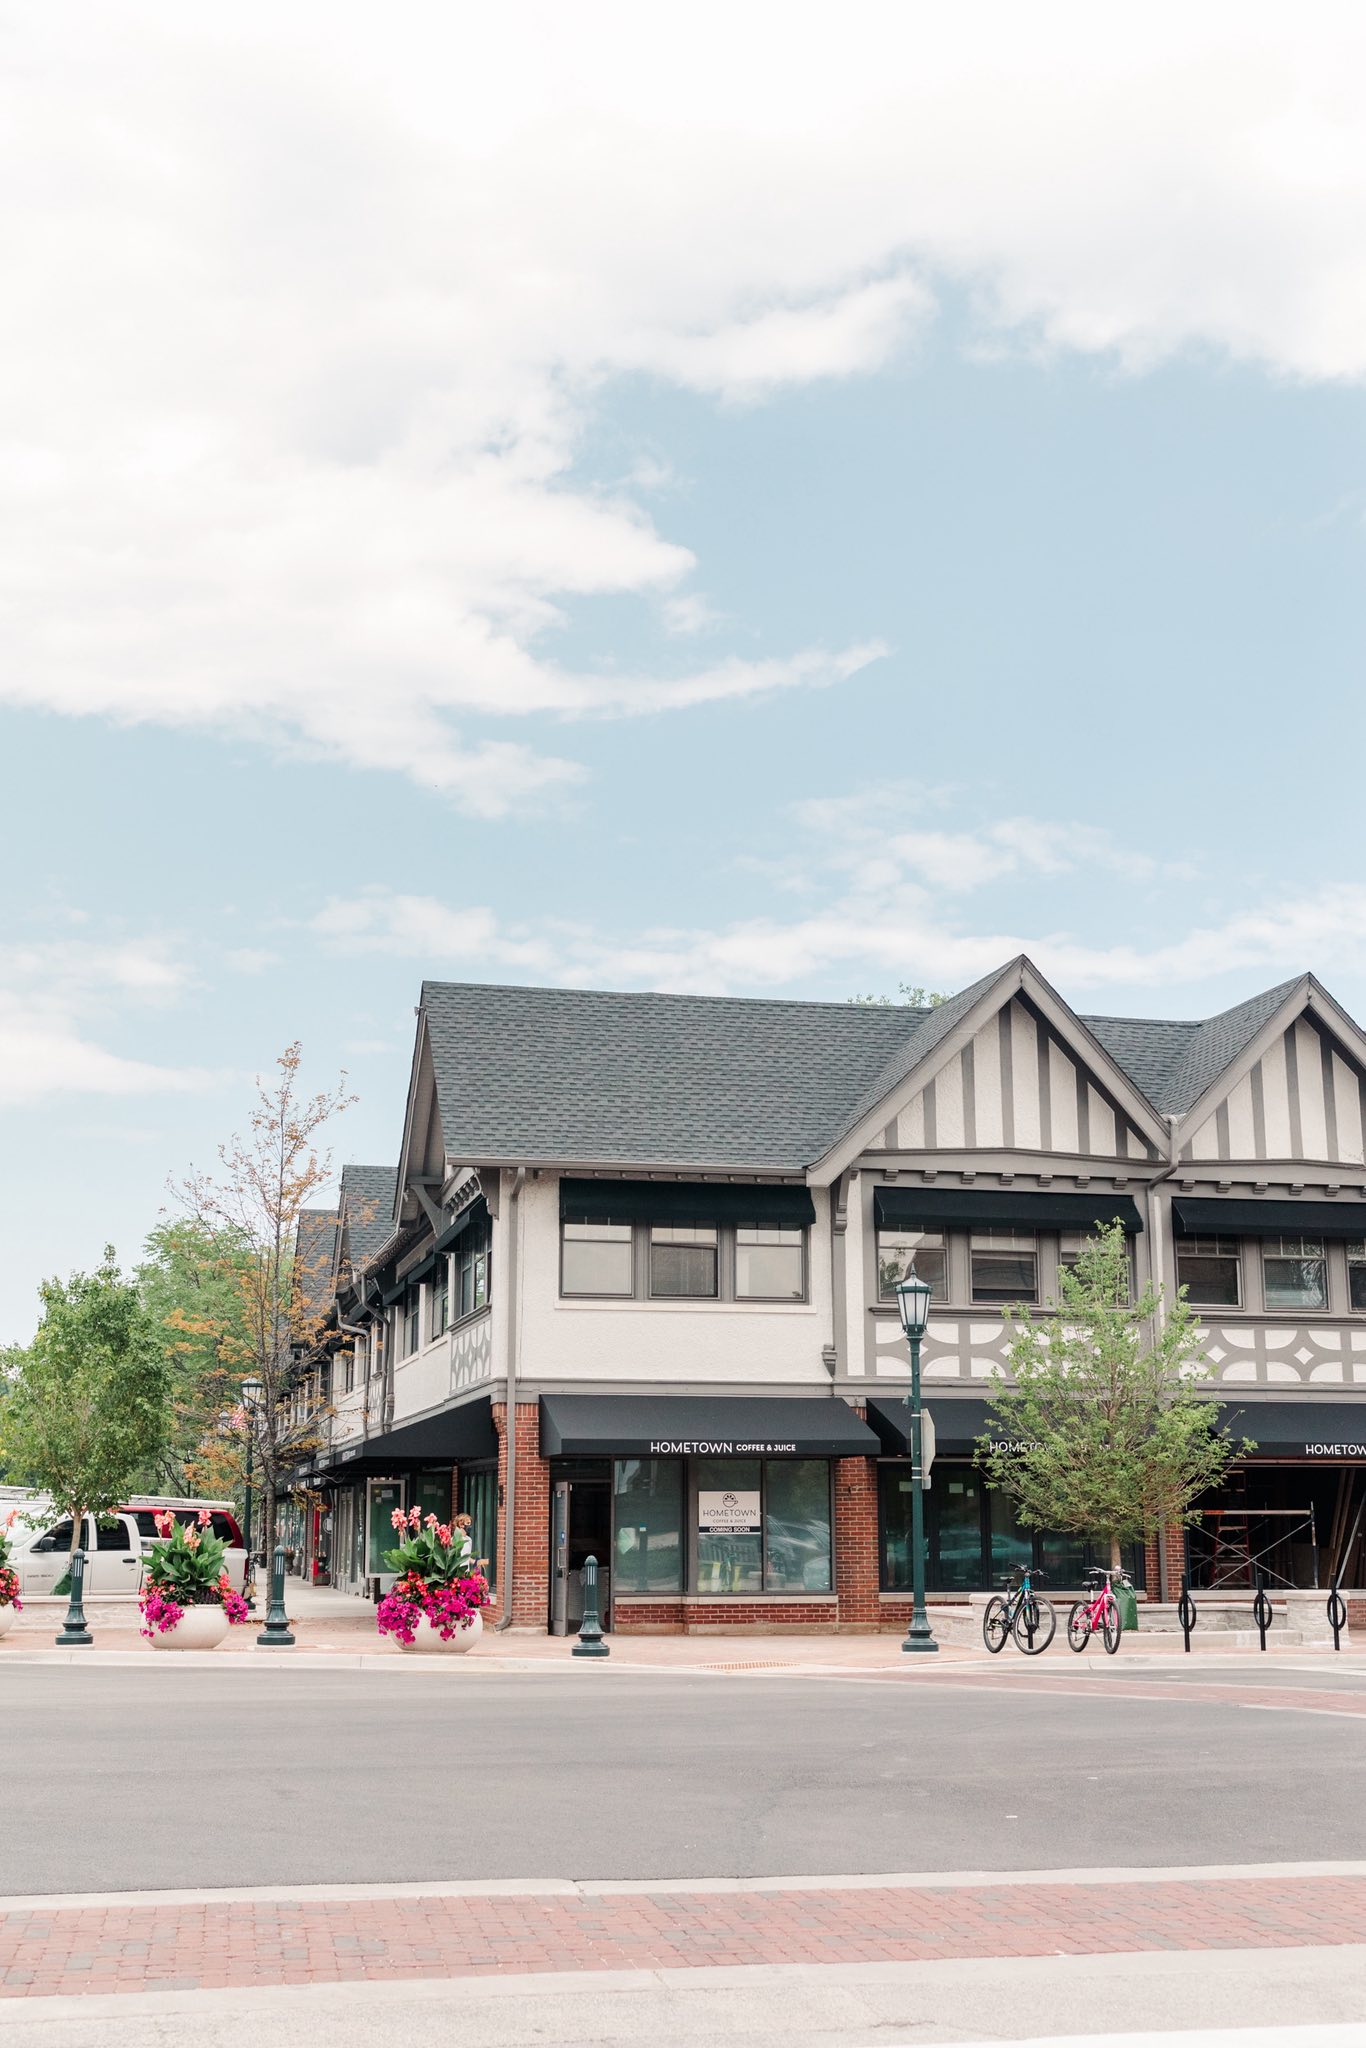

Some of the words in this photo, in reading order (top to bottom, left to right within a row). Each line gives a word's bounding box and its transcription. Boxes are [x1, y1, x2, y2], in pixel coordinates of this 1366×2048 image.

[650, 1441, 733, 1453] HOMETOWN
[736, 1443, 765, 1452] COFFEE
[766, 1443, 772, 1452] &
[773, 1443, 796, 1452] JUICE
[702, 1509, 757, 1517] HOMETOWN
